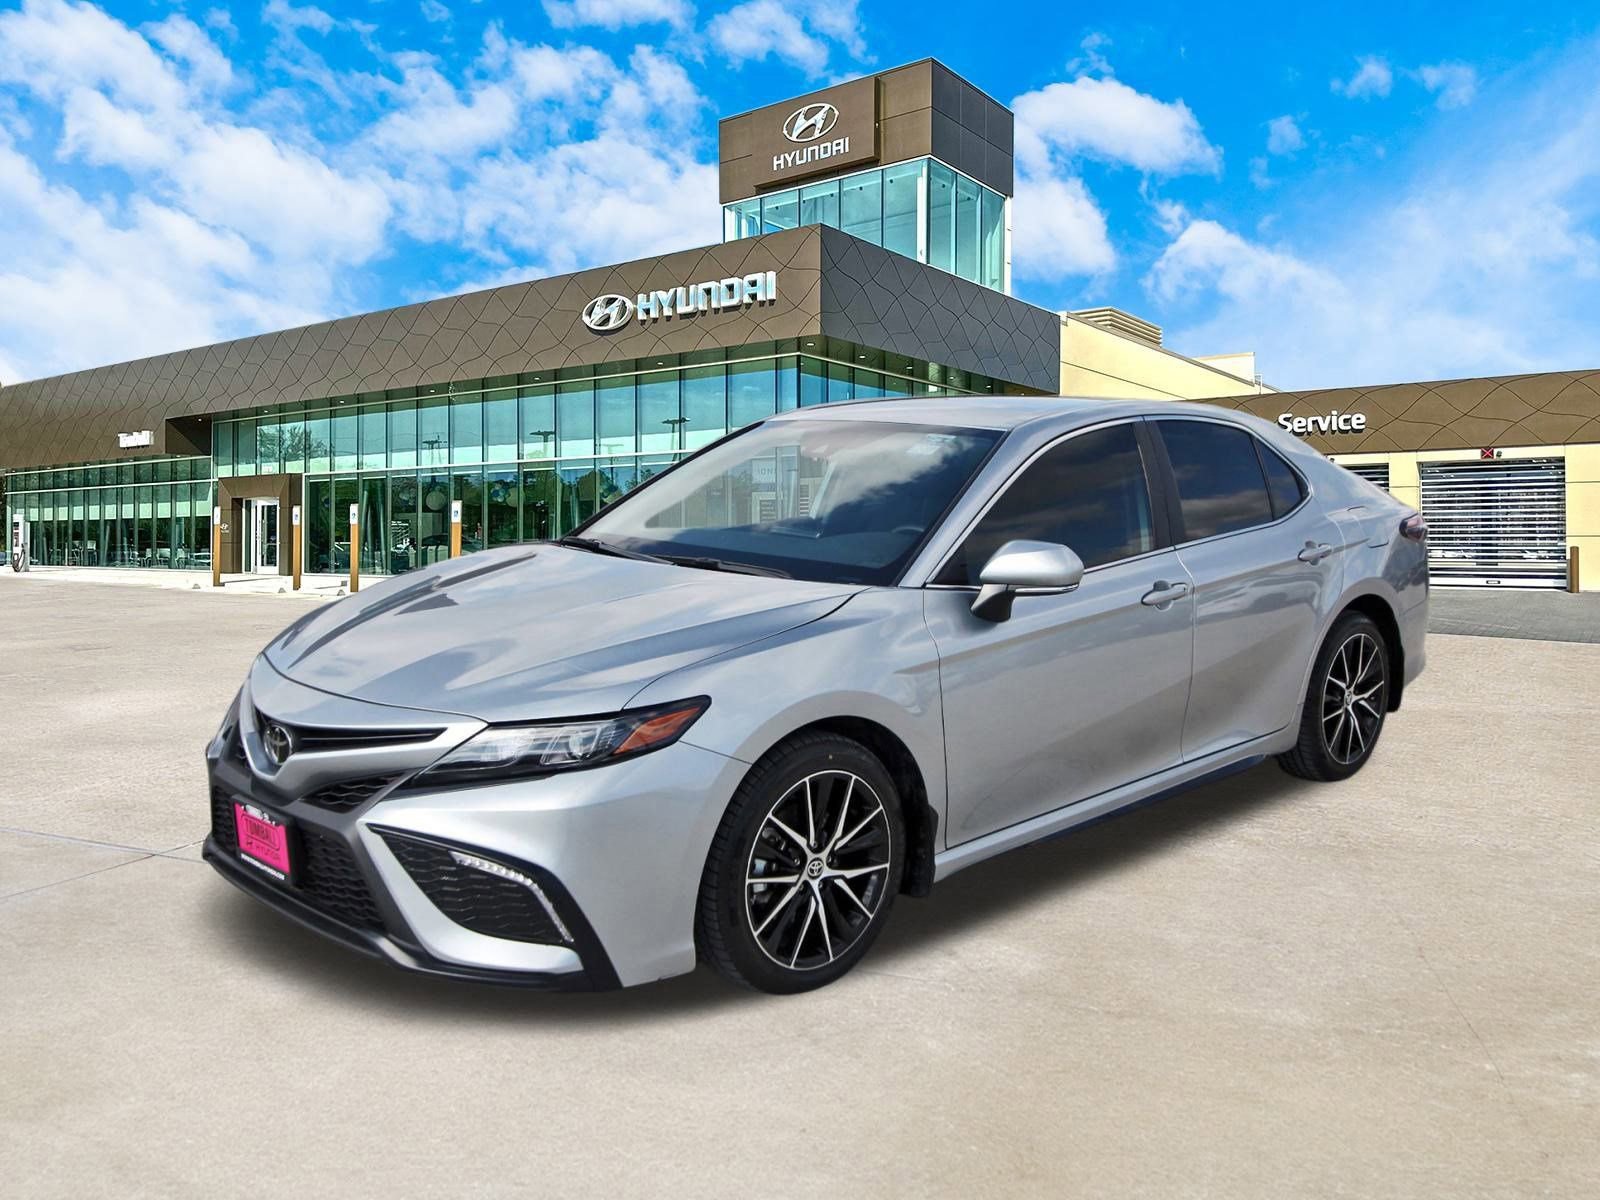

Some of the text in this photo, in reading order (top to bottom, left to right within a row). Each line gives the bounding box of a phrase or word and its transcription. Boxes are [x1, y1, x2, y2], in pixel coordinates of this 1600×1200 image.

[773, 137, 849, 171] HYUNDAI
[637, 270, 777, 321] HYUNDAI
[1278, 410, 1367, 433] Service
